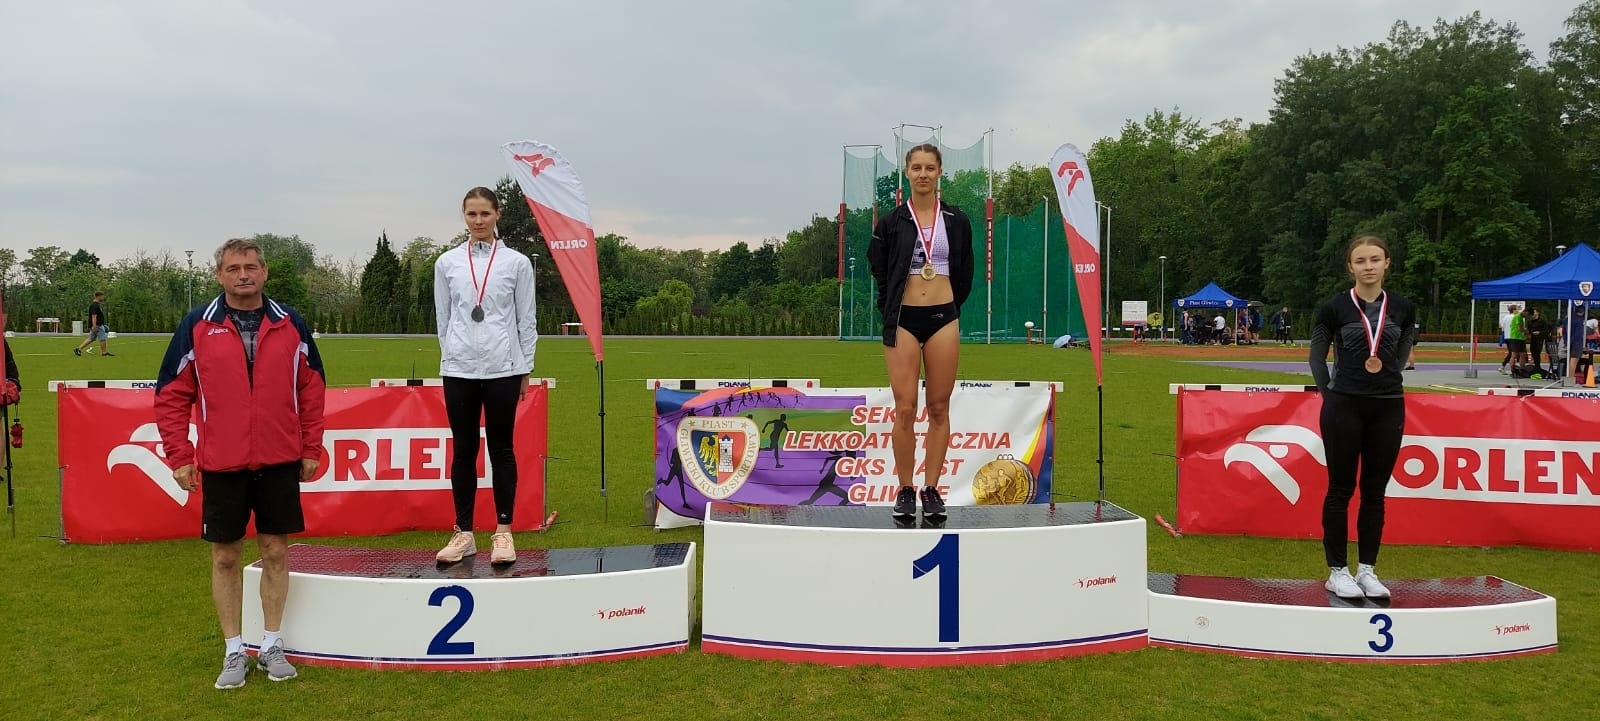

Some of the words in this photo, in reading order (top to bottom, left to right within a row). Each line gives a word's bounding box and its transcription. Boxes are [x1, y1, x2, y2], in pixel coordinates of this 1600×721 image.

[852, 406, 931, 424] SEKJ
[702, 420, 735, 429] PIAST
[786, 432, 1011, 450] LEKKOATTCZNA
[680, 428, 701, 481] GLIWICKI
[700, 480, 730, 496] KLUB
[729, 432, 757, 489] SPORTOWY
[837, 458, 886, 476] GKS
[892, 458, 965, 476] AST
[1391, 444, 1600, 496] ORLEN
[913, 533, 960, 643] 1
[1086, 574, 1117, 588] polanik
[427, 584, 475, 655] 2
[608, 605, 646, 620] polanik
[1368, 613, 1394, 653] 3
[1503, 621, 1531, 635] polanik
